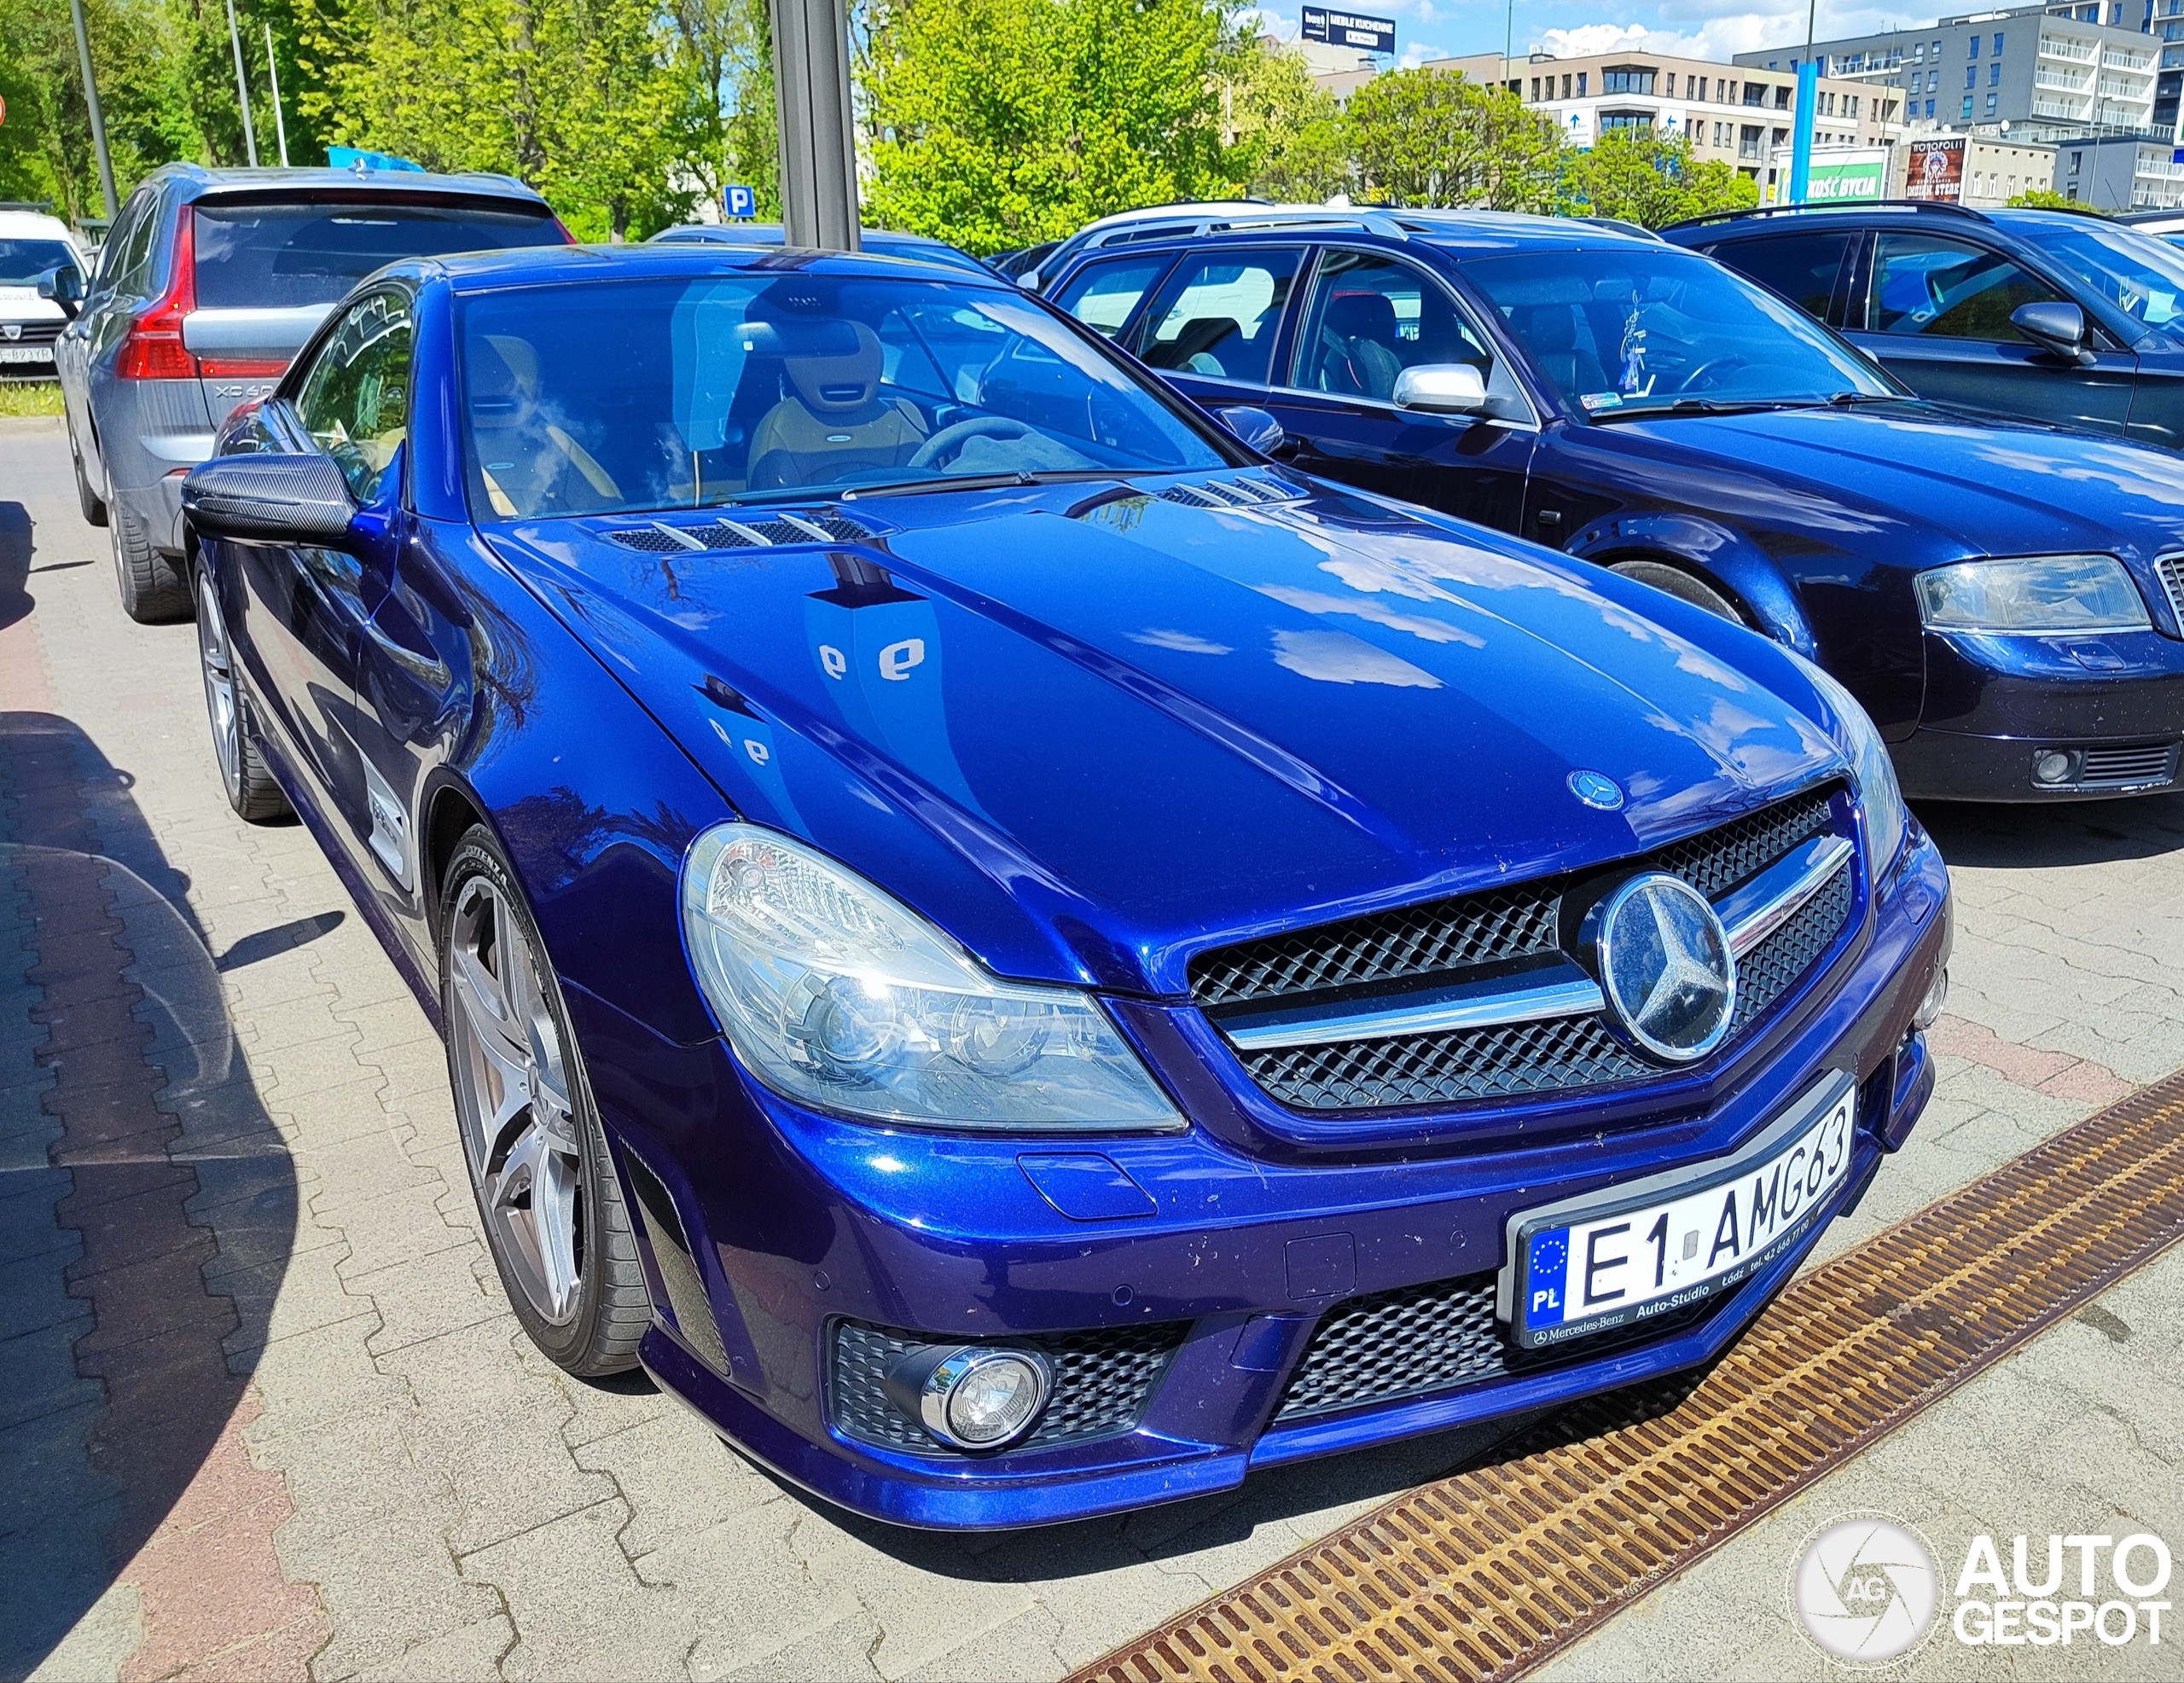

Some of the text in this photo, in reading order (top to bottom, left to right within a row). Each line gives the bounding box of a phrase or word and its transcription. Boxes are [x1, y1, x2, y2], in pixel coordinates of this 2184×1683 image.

[1838, 176, 1877, 197] BYCIA
[730, 189, 748, 213] P
[1583, 1106, 1847, 1307] E1 AMG63
[1532, 1287, 1560, 1313] PL
[1548, 1314, 1624, 1341] Mercedes-Benz
[1635, 1285, 1710, 1319] Auto-Studio
[1722, 1266, 1745, 1286] Łódź
[1750, 1258, 1763, 1272] tel.
